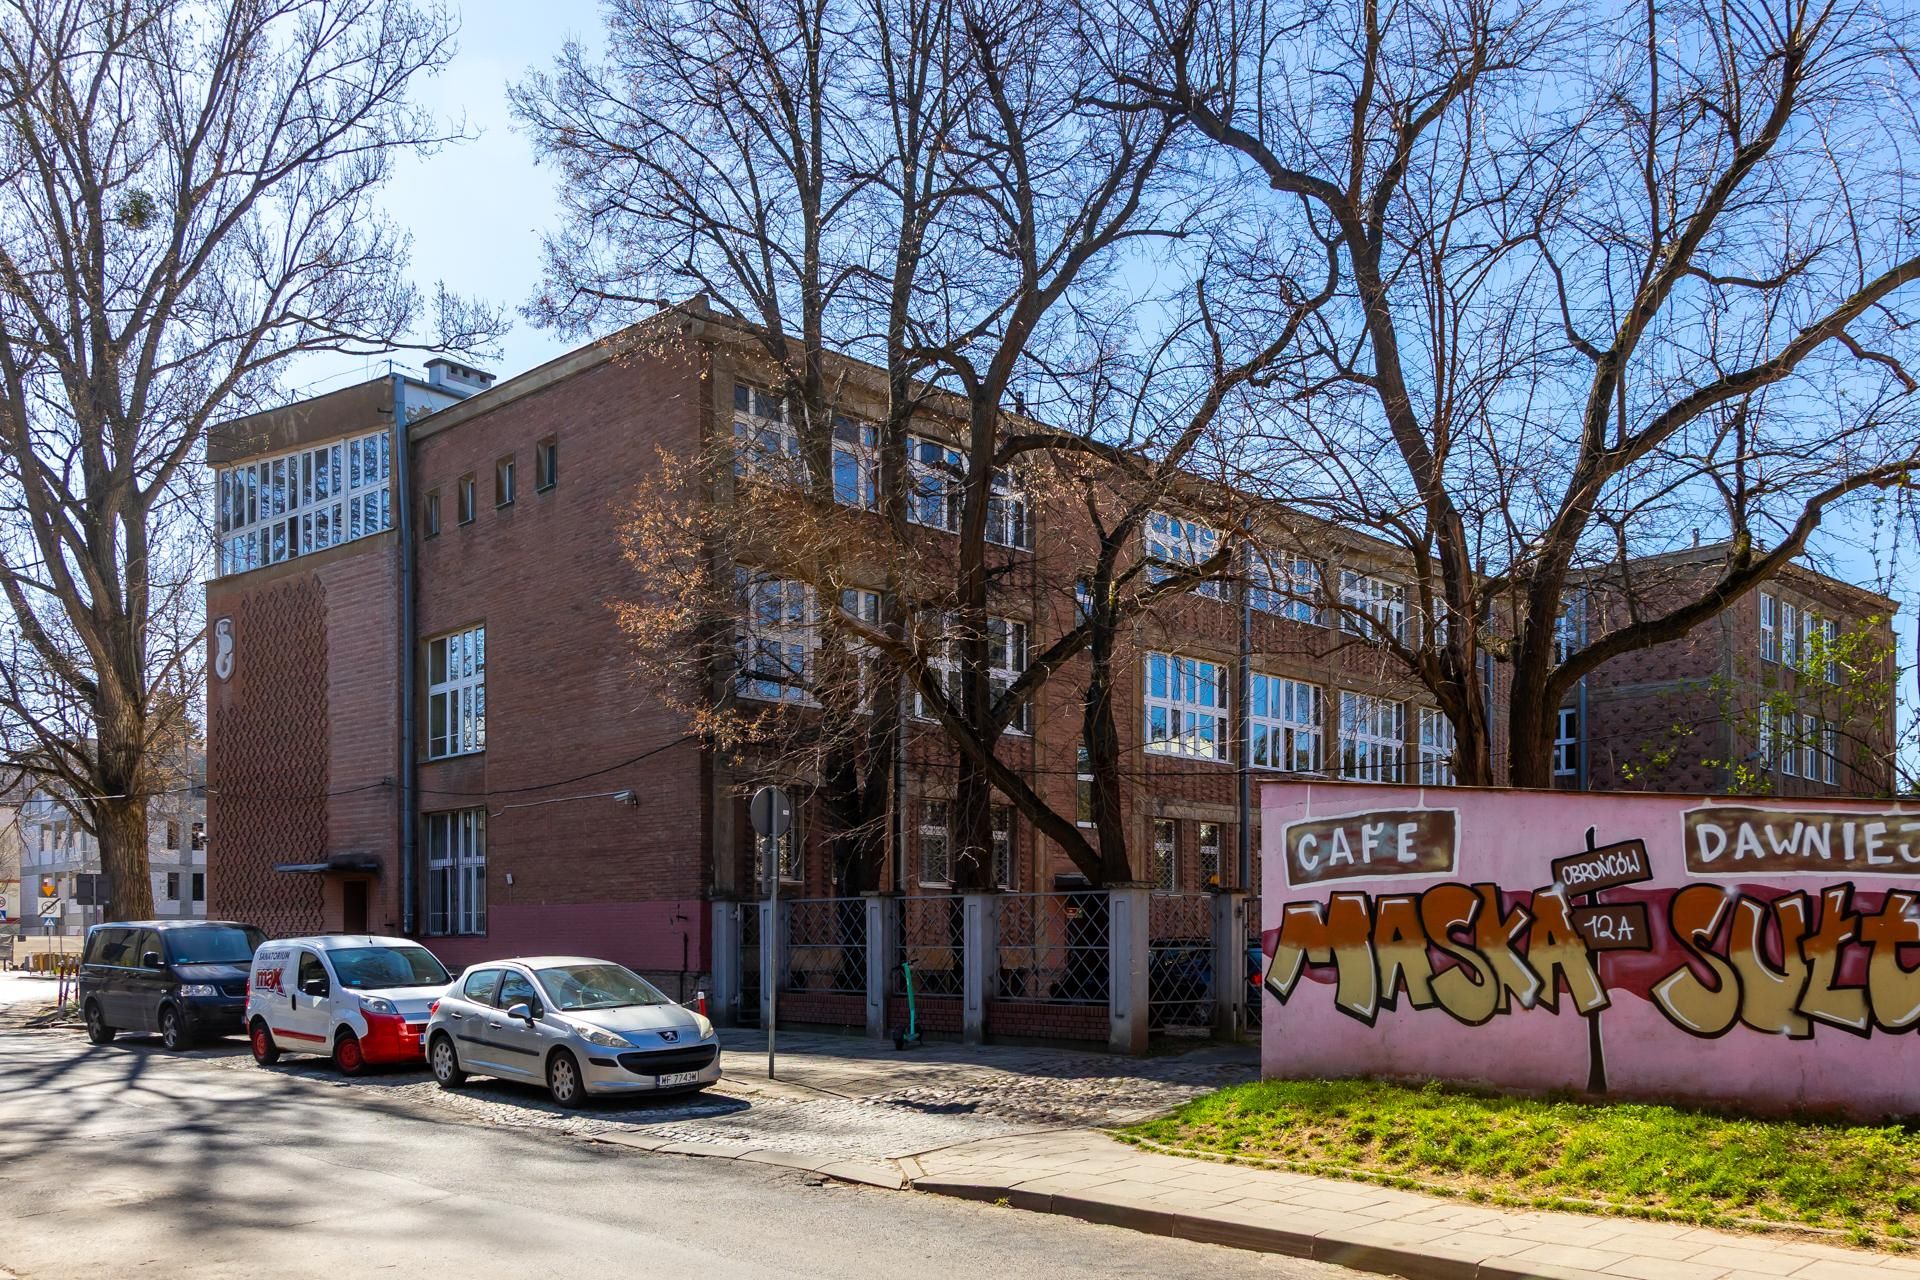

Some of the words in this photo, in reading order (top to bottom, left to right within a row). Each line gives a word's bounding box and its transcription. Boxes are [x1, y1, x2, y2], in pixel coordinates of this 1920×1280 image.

[1299, 822, 1418, 871] CAFE
[1563, 849, 1640, 884] OBROŃCÓW
[1265, 882, 1611, 1027] MASKA
